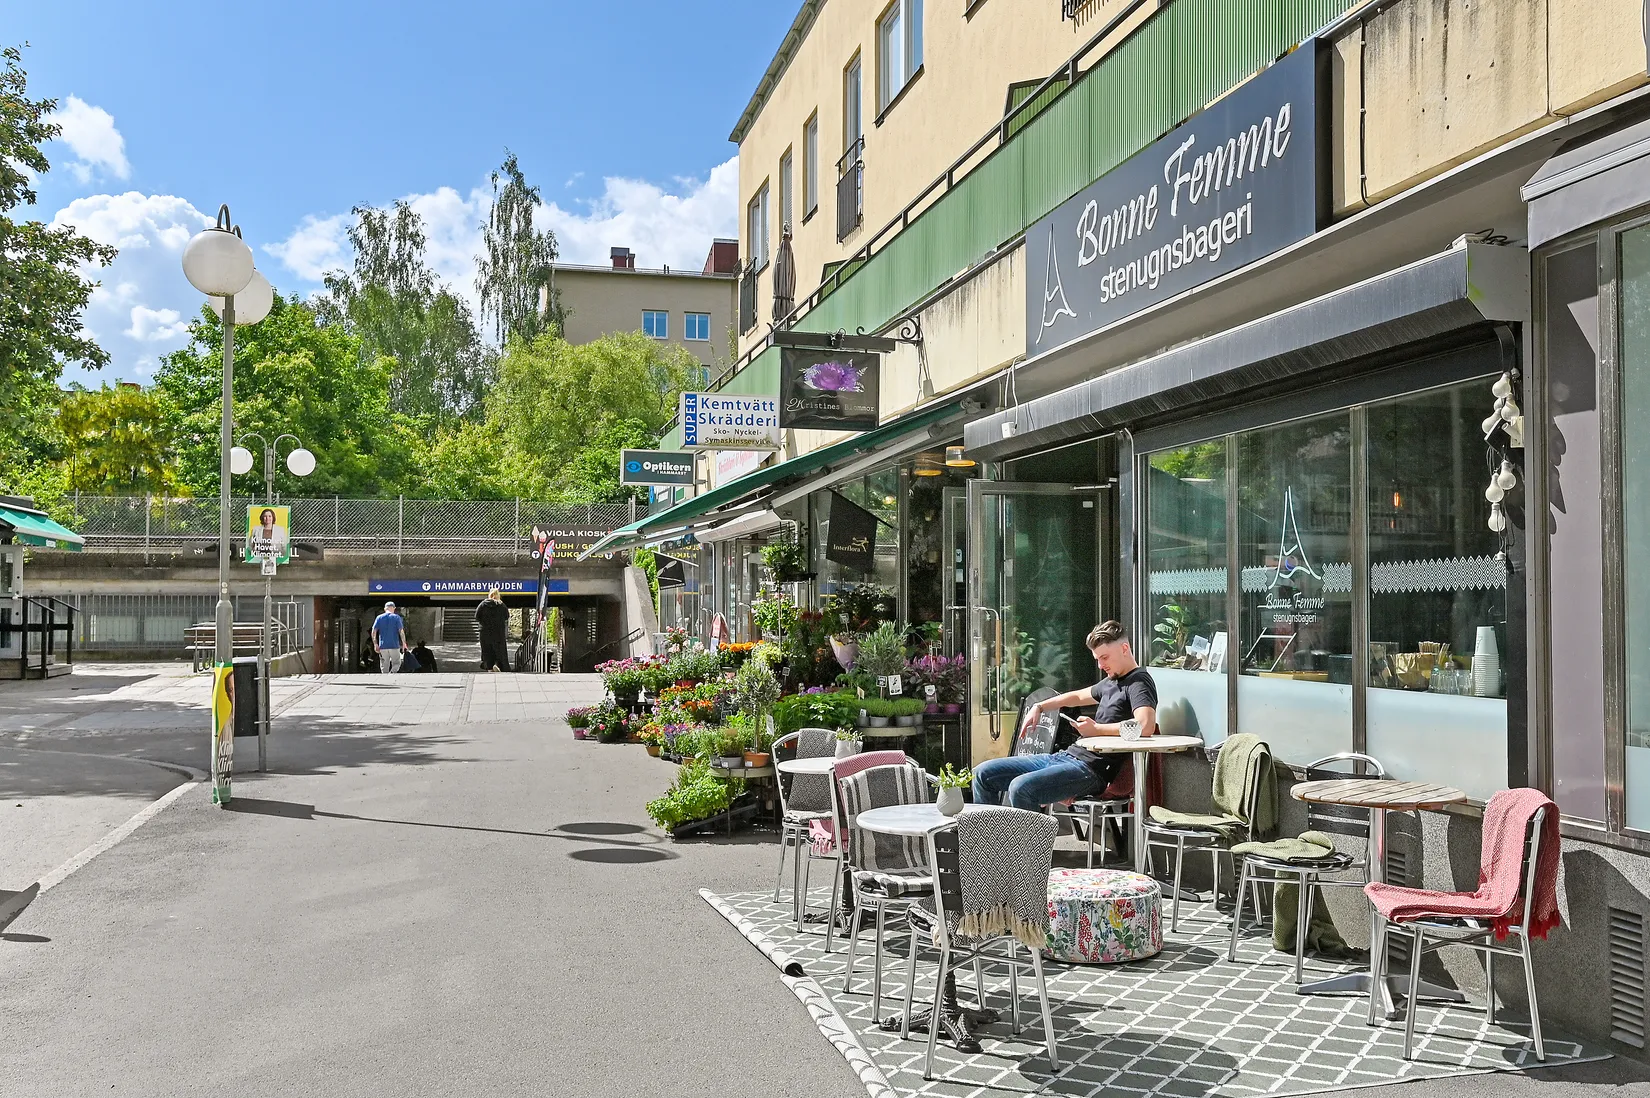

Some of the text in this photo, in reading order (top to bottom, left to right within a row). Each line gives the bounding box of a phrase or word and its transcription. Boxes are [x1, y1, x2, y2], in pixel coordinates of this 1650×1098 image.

[1077, 102, 1291, 267] Bonne Femme
[1100, 192, 1252, 303] stenugnsbageri
[701, 397, 775, 412] Kemtvätt
[785, 397, 840, 412] Kristines
[685, 398, 695, 442] SUPER
[698, 412, 777, 427] Skrädderi
[734, 428, 762, 437] Nyckel-
[704, 436, 771, 445] Symaskinsservice
[643, 461, 692, 473] Optikern
[577, 530, 607, 538] KIOSK
[254, 543, 279, 551] Havet.
[833, 544, 860, 553] Interflora
[251, 550, 284, 558] Klimatet.
[435, 581, 523, 591] HAMMARBYHÖJDEN
[1265, 592, 1325, 609] Bonne Femme
[1273, 612, 1317, 625] stenugnsbageri
